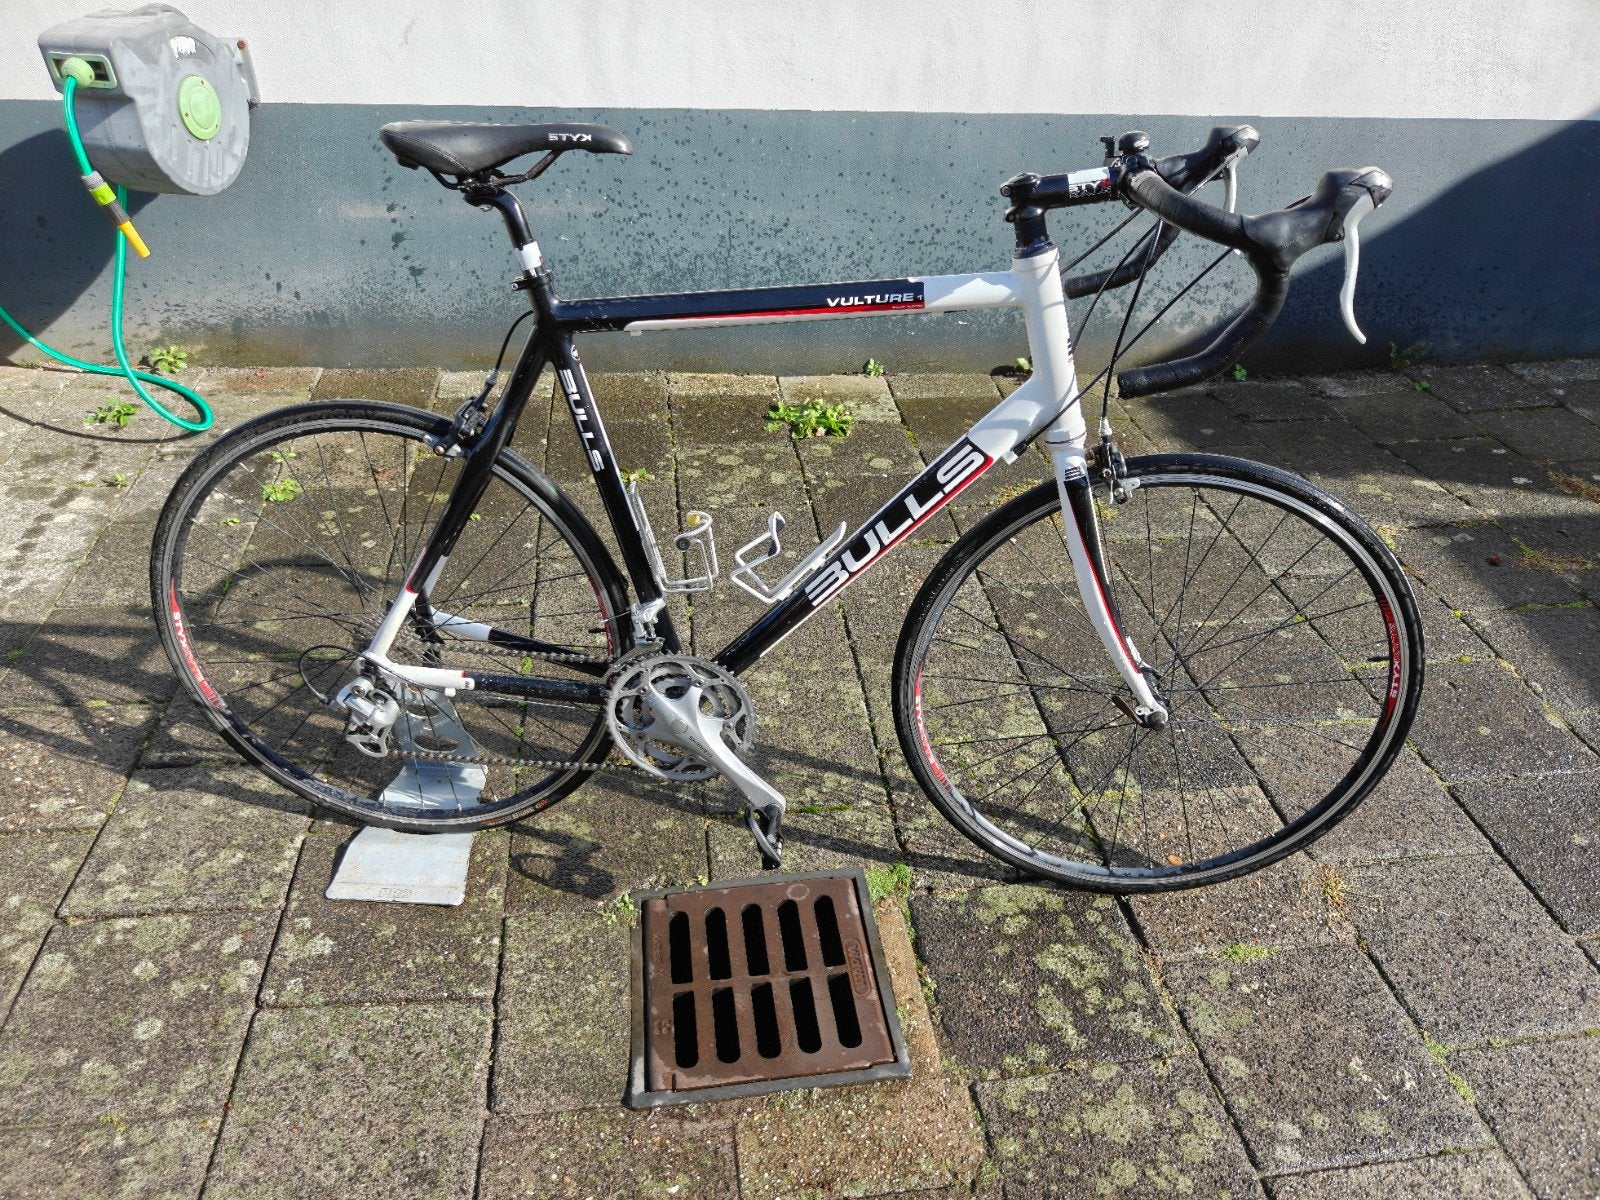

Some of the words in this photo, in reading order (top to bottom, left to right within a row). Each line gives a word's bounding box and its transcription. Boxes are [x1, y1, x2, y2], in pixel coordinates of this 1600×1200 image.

[548, 132, 592, 141] STYX
[827, 293, 914, 307] VULTURE
[559, 369, 605, 472] BULLS
[804, 444, 985, 607] BULLS
